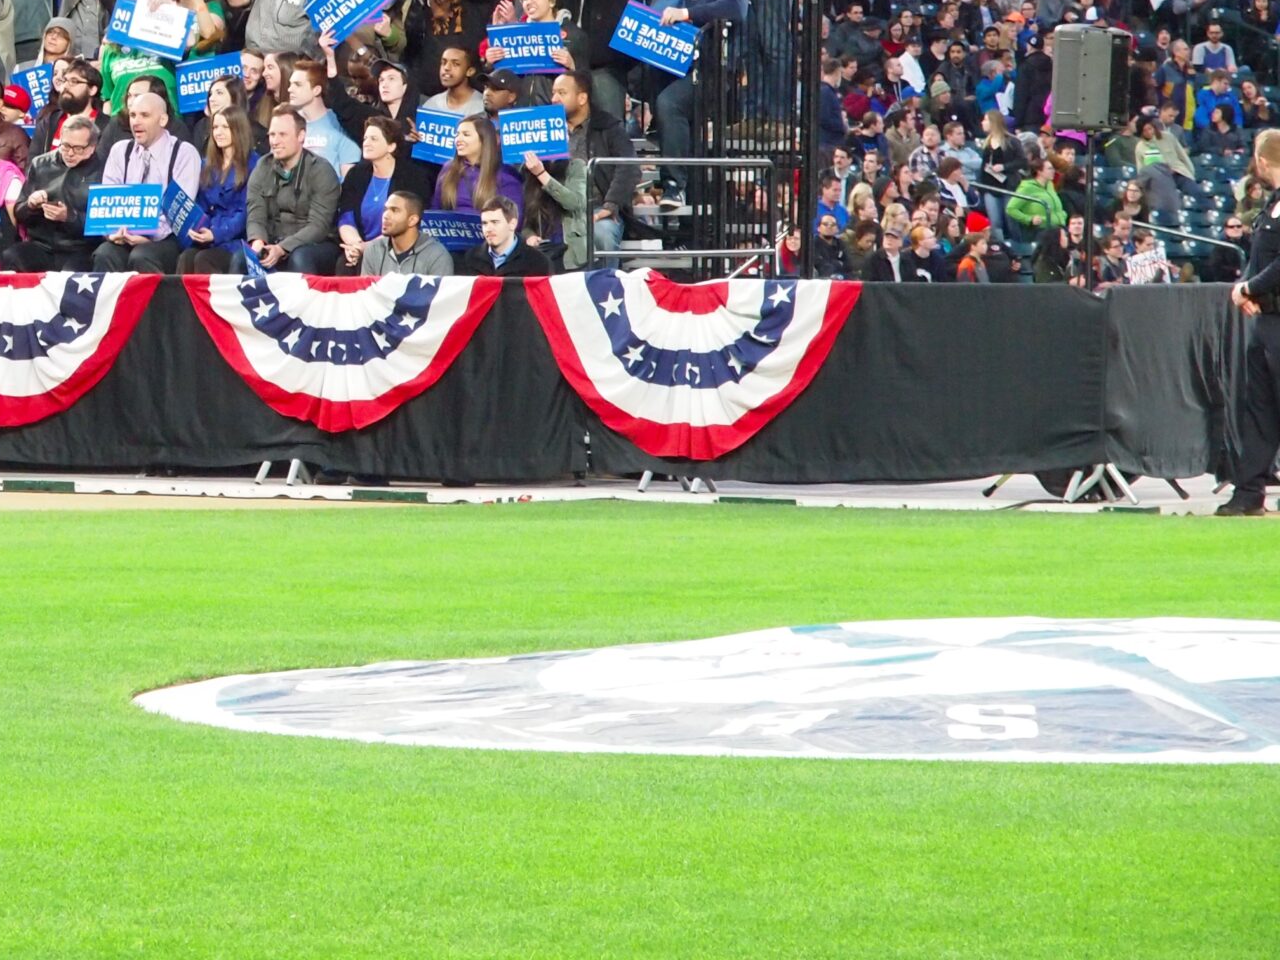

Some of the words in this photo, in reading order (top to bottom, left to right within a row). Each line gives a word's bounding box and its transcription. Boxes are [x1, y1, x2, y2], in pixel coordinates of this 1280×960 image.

[115, 8, 131, 22] IN
[314, 13, 322, 23] A
[112, 21, 128, 33] TO
[621, 16, 637, 30] IN
[493, 37, 502, 46] A
[502, 35, 543, 46] FUTURE
[544, 34, 560, 45] TO
[617, 30, 632, 40] TO
[639, 24, 694, 55] BELIEVE
[504, 46, 543, 58] ELIEVE
[635, 37, 678, 61] FUTURE
[680, 53, 688, 64] A
[180, 74, 187, 84] A
[227, 65, 241, 76] TO
[26, 71, 45, 108] BELIE
[419, 121, 426, 130] A
[429, 123, 456, 137] FUTU
[502, 123, 509, 132] A
[510, 119, 546, 131] FUTURE
[549, 117, 563, 128] TO
[419, 133, 454, 148] BELIE
[502, 131, 548, 146] BELIEVE
[551, 129, 565, 141] IN
[91, 197, 99, 206] A
[101, 196, 141, 206] FUTURE
[144, 196, 159, 206] TO
[176, 190, 186, 201] TO
[183, 198, 195, 210] IN
[89, 207, 141, 218] BELIEVE
[143, 206, 158, 218] IN
[420, 219, 428, 227] A
[429, 219, 468, 229] FUTURE
[470, 222, 483, 230] TO
[422, 228, 473, 238] BELIEVE
